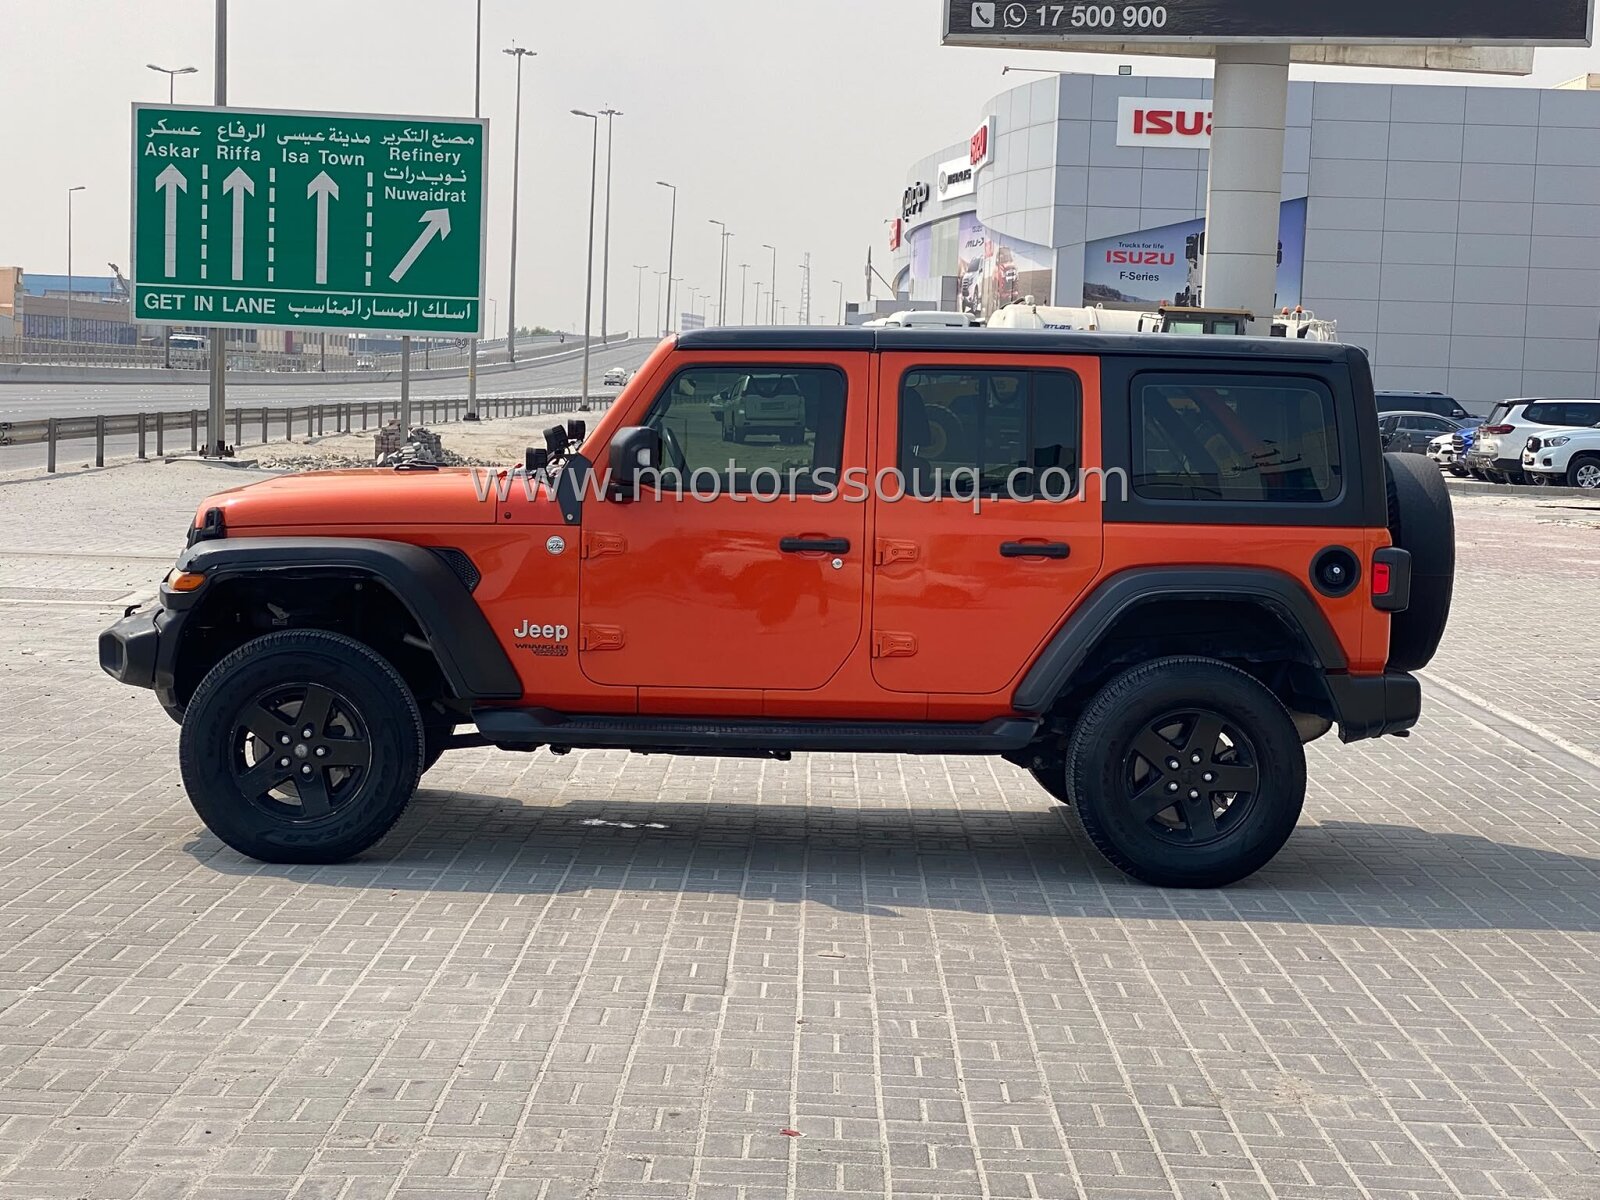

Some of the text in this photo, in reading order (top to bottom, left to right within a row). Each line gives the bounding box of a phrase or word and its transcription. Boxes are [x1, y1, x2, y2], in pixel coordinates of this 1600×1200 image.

[1036, 6, 1167, 27] 17 500 900
[146, 118, 202, 138] عسكر
[217, 120, 265, 142] الرفاع
[1133, 109, 1213, 136] ISU
[328, 127, 371, 147] مدينة
[379, 128, 475, 148] مصنع التكرير
[145, 142, 200, 158] Askar
[216, 144, 261, 161] Riffa
[282, 148, 365, 166] Isa Town
[389, 146, 461, 166] Refinery
[383, 165, 467, 186] نويدرات
[384, 185, 466, 203] Nuwaidrat
[1106, 250, 1175, 265] ISUZU
[1119, 271, 1159, 282] F-Series
[144, 293, 276, 314] GET IN LANE
[288, 298, 471, 320] اسلك المسار المناسب
[514, 620, 568, 642] Jeep
